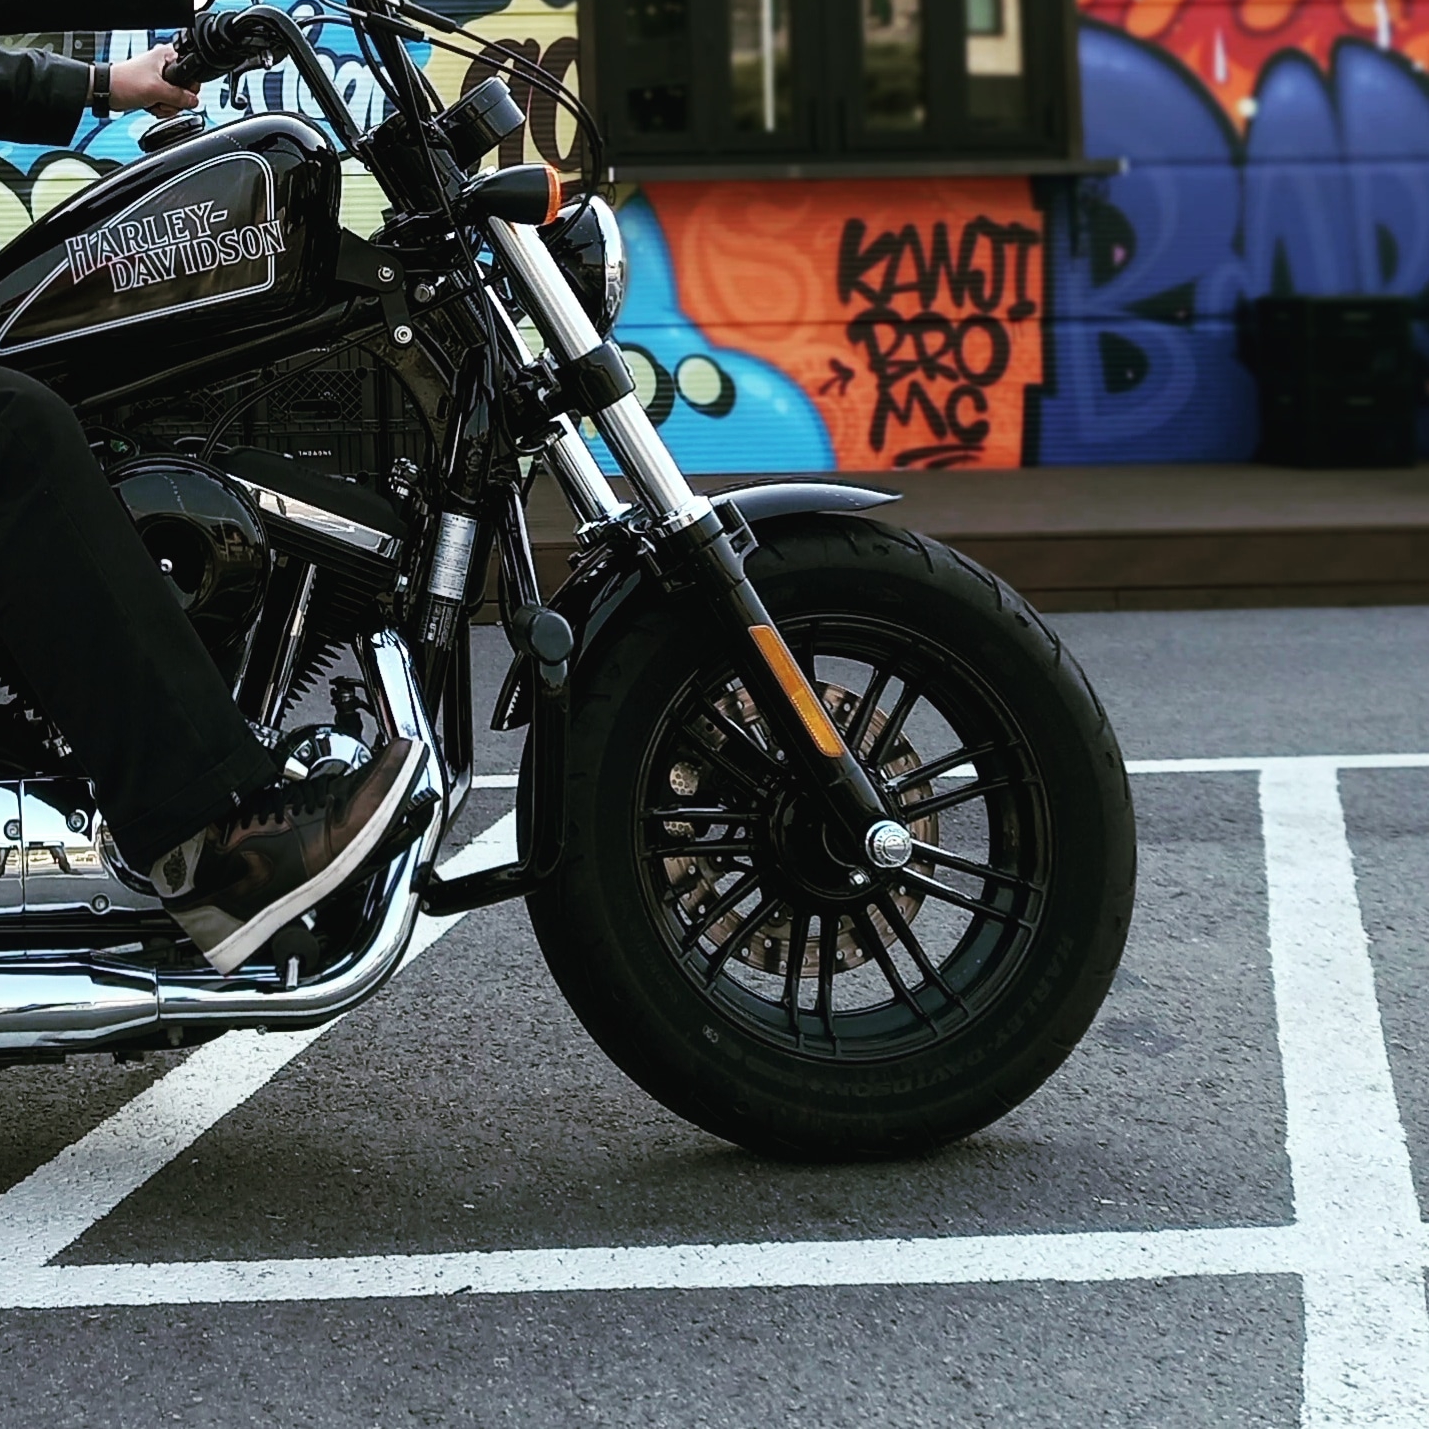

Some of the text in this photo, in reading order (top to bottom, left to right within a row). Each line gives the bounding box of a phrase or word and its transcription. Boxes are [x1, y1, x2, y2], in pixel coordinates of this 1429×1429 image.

[65, 200, 229, 285] HARLEY-
[107, 219, 287, 293] DAVIDSON
[836, 214, 1041, 323] KANJI
[868, 379, 991, 453] MC
